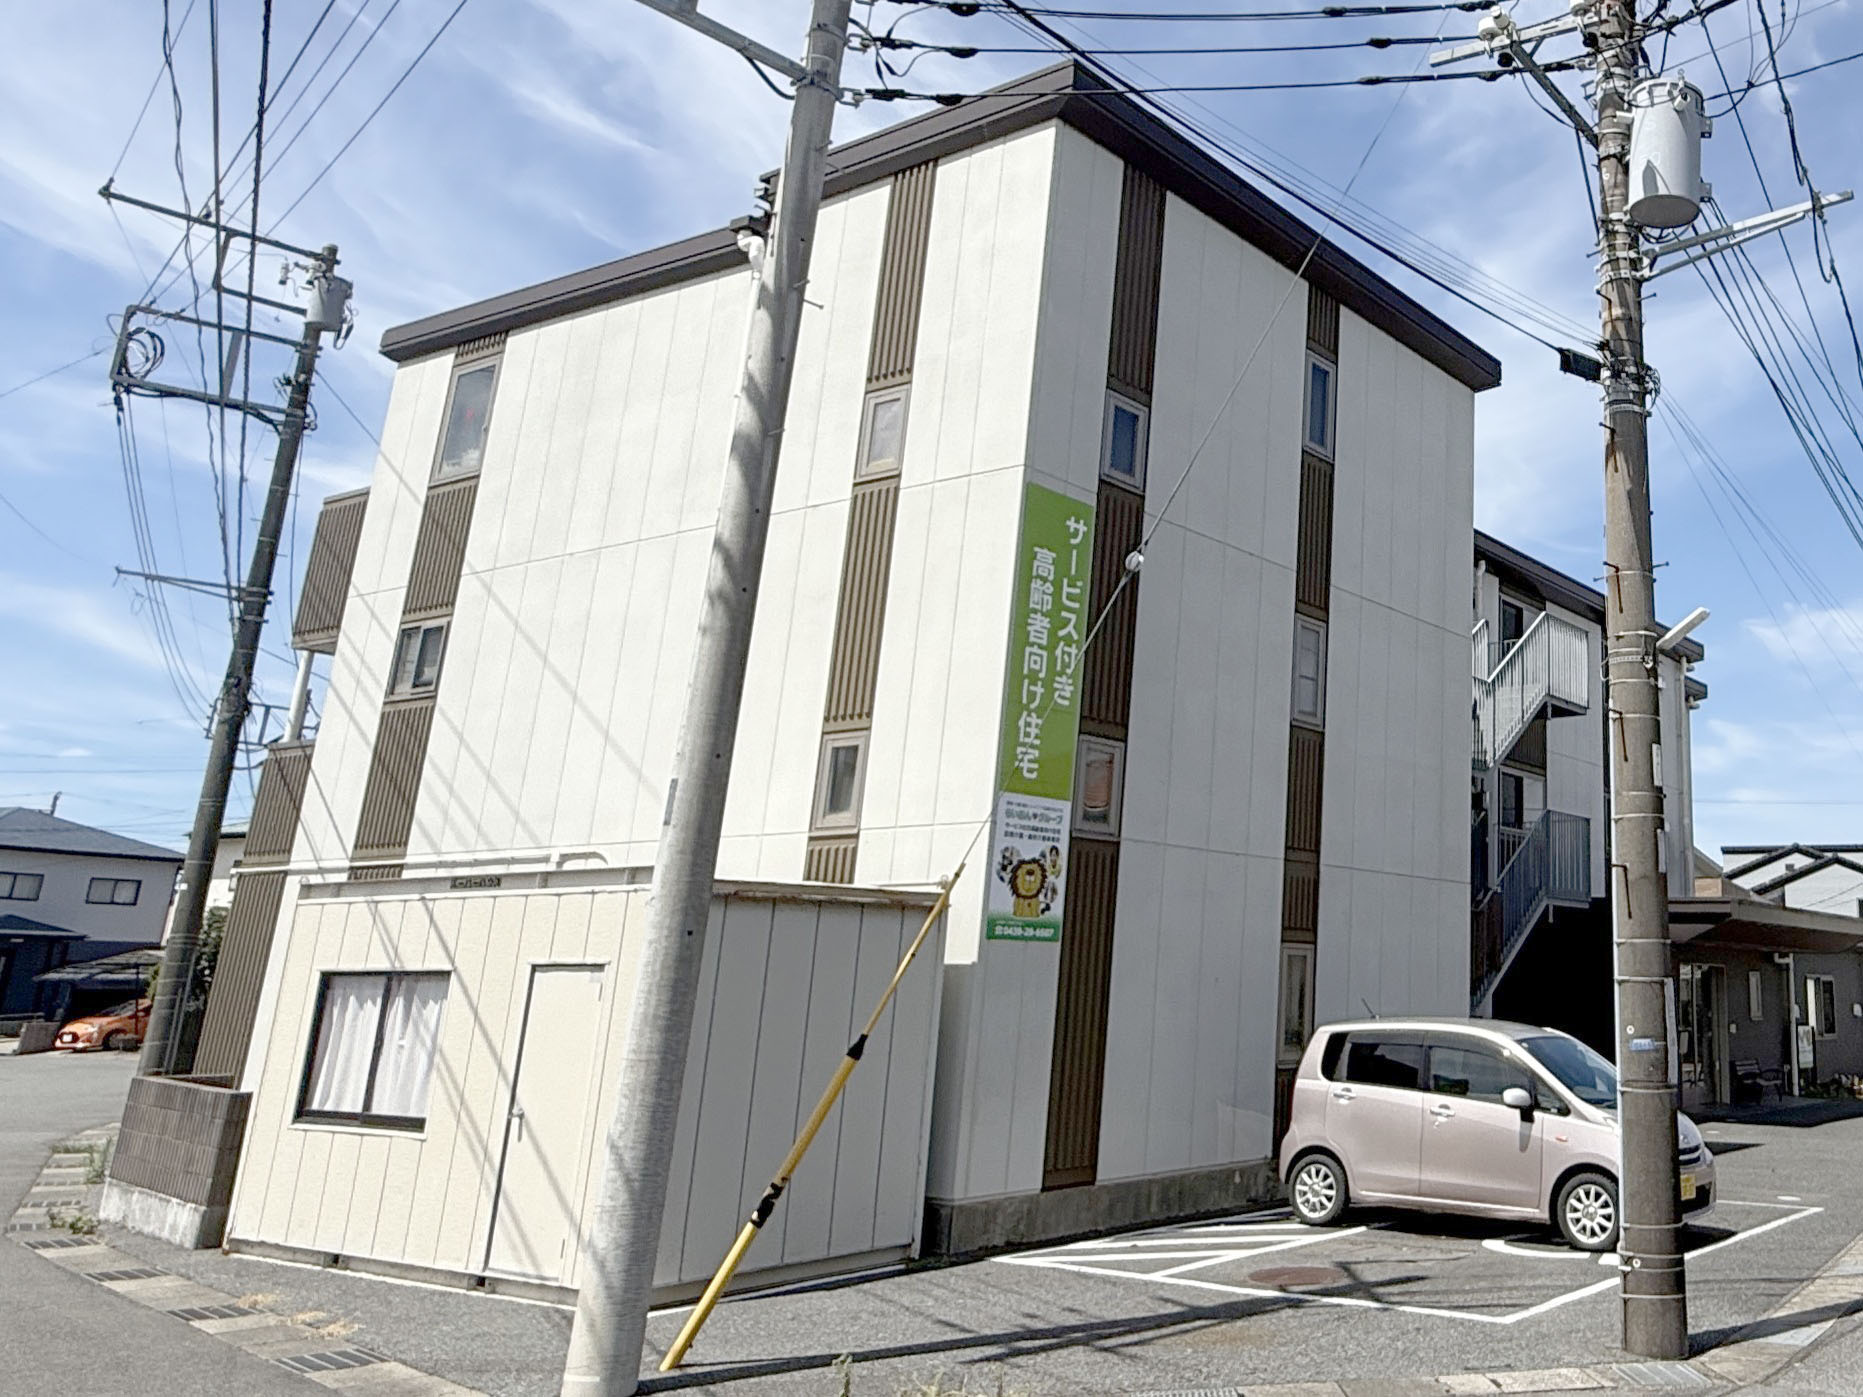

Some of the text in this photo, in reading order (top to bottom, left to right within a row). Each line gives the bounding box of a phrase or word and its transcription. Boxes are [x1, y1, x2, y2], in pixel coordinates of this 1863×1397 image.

[1015, 546, 1057, 780] 高齢者向け住宅
[1053, 516, 1088, 706] サービス付き
